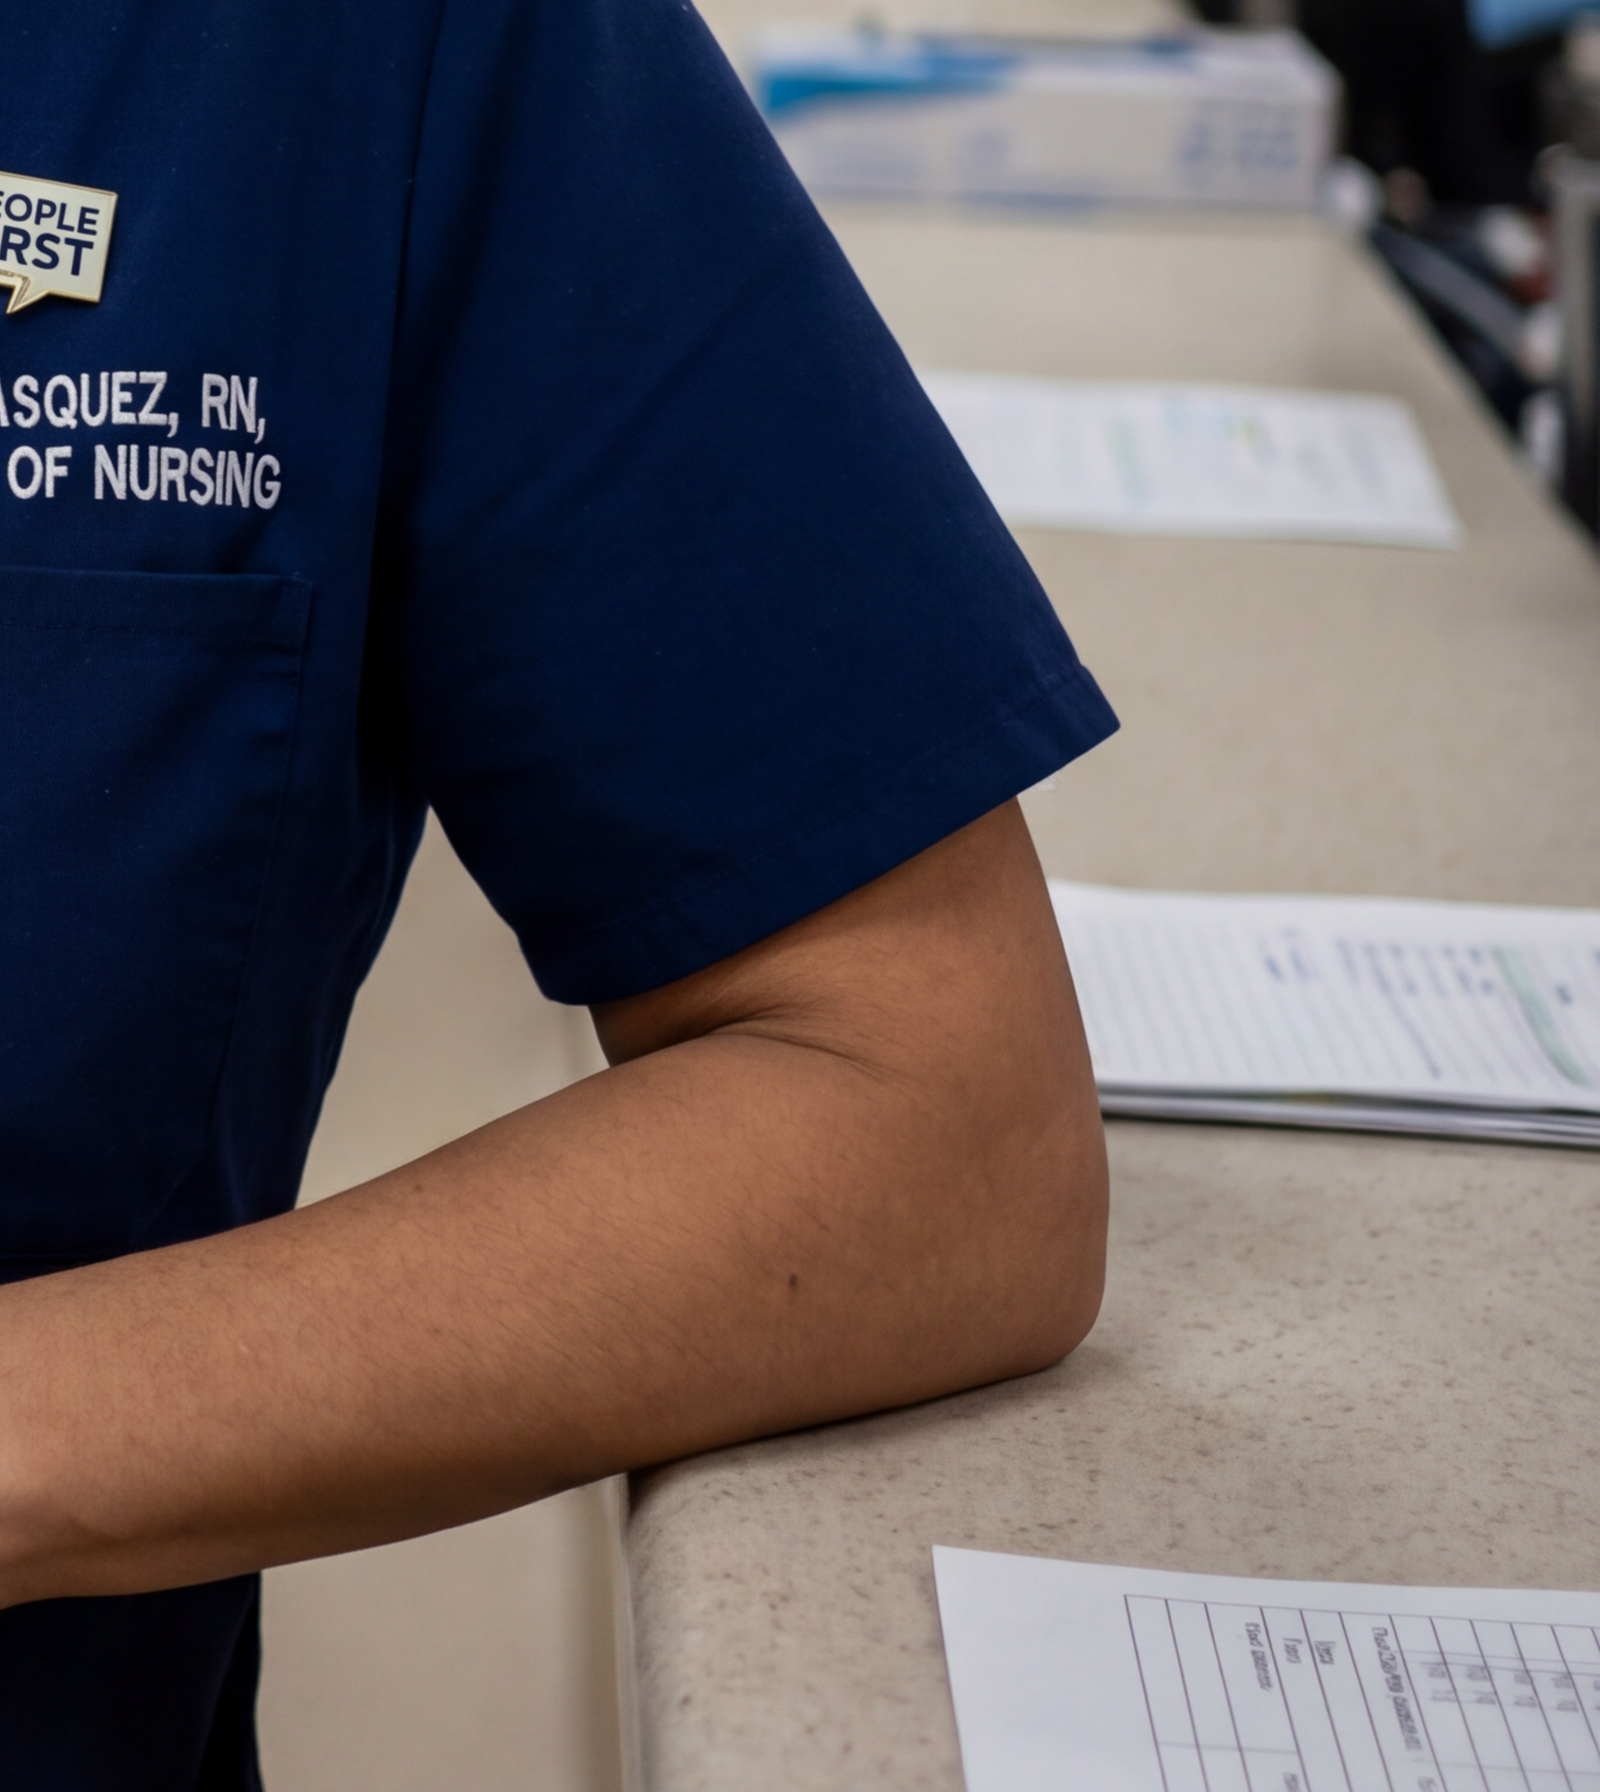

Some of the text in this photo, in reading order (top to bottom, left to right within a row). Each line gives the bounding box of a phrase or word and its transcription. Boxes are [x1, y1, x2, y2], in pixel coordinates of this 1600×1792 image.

[201, 373, 266, 445] RN,
[7, 445, 73, 500] OF
[94, 444, 282, 510] NURSING
